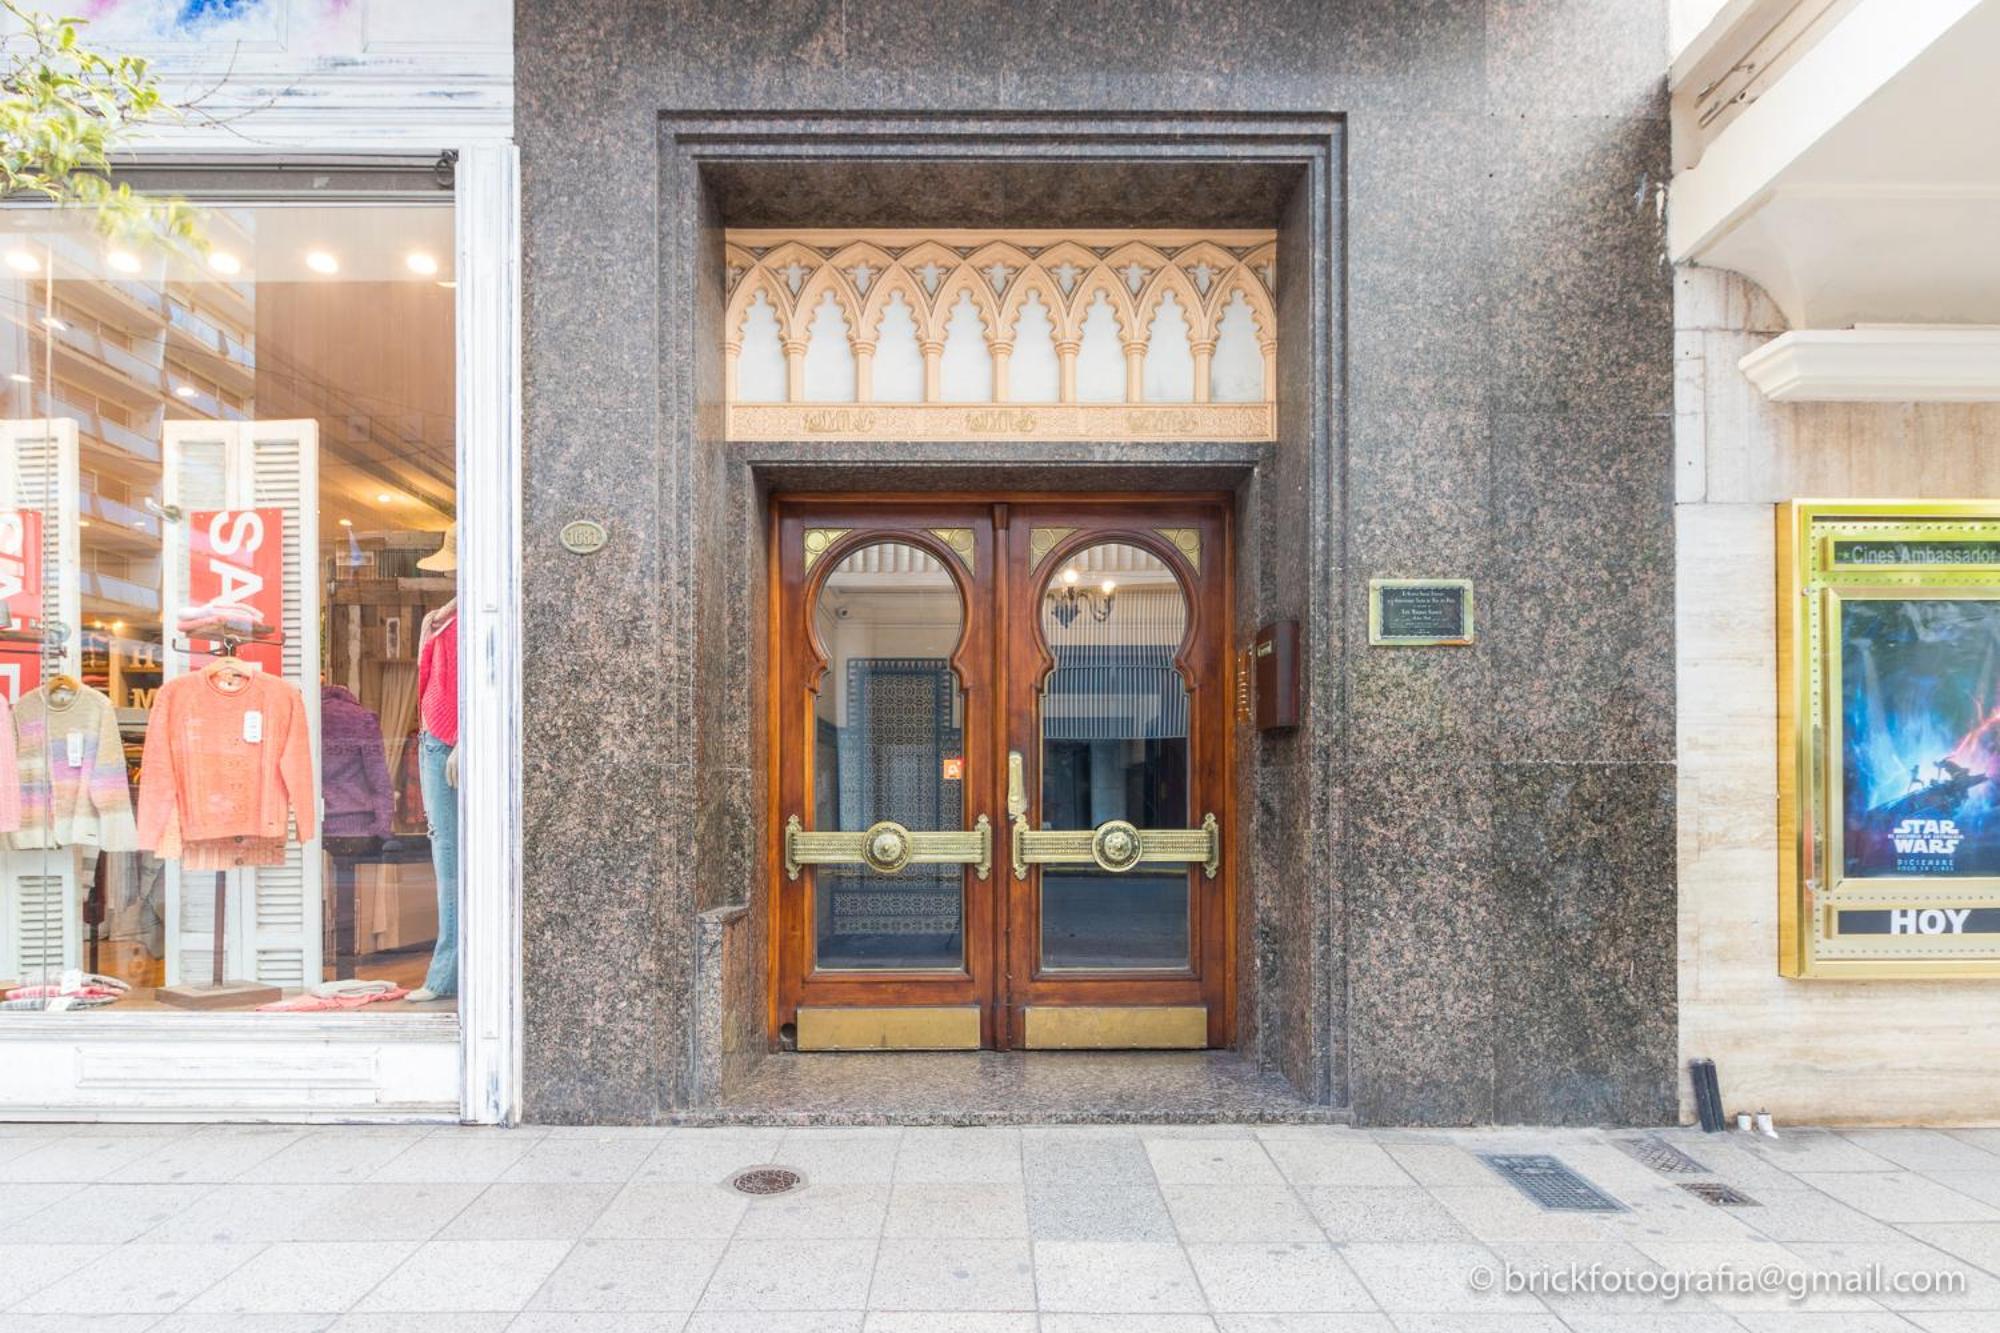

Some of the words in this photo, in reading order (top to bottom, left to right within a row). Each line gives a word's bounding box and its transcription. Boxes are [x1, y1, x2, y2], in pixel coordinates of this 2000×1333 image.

[1852, 544, 1895, 564] Cines
[1901, 545, 1997, 564] Ambassador
[1893, 819, 1959, 834] STAR
[1894, 839, 1959, 853] WARS
[1891, 909, 1971, 935] HOY
